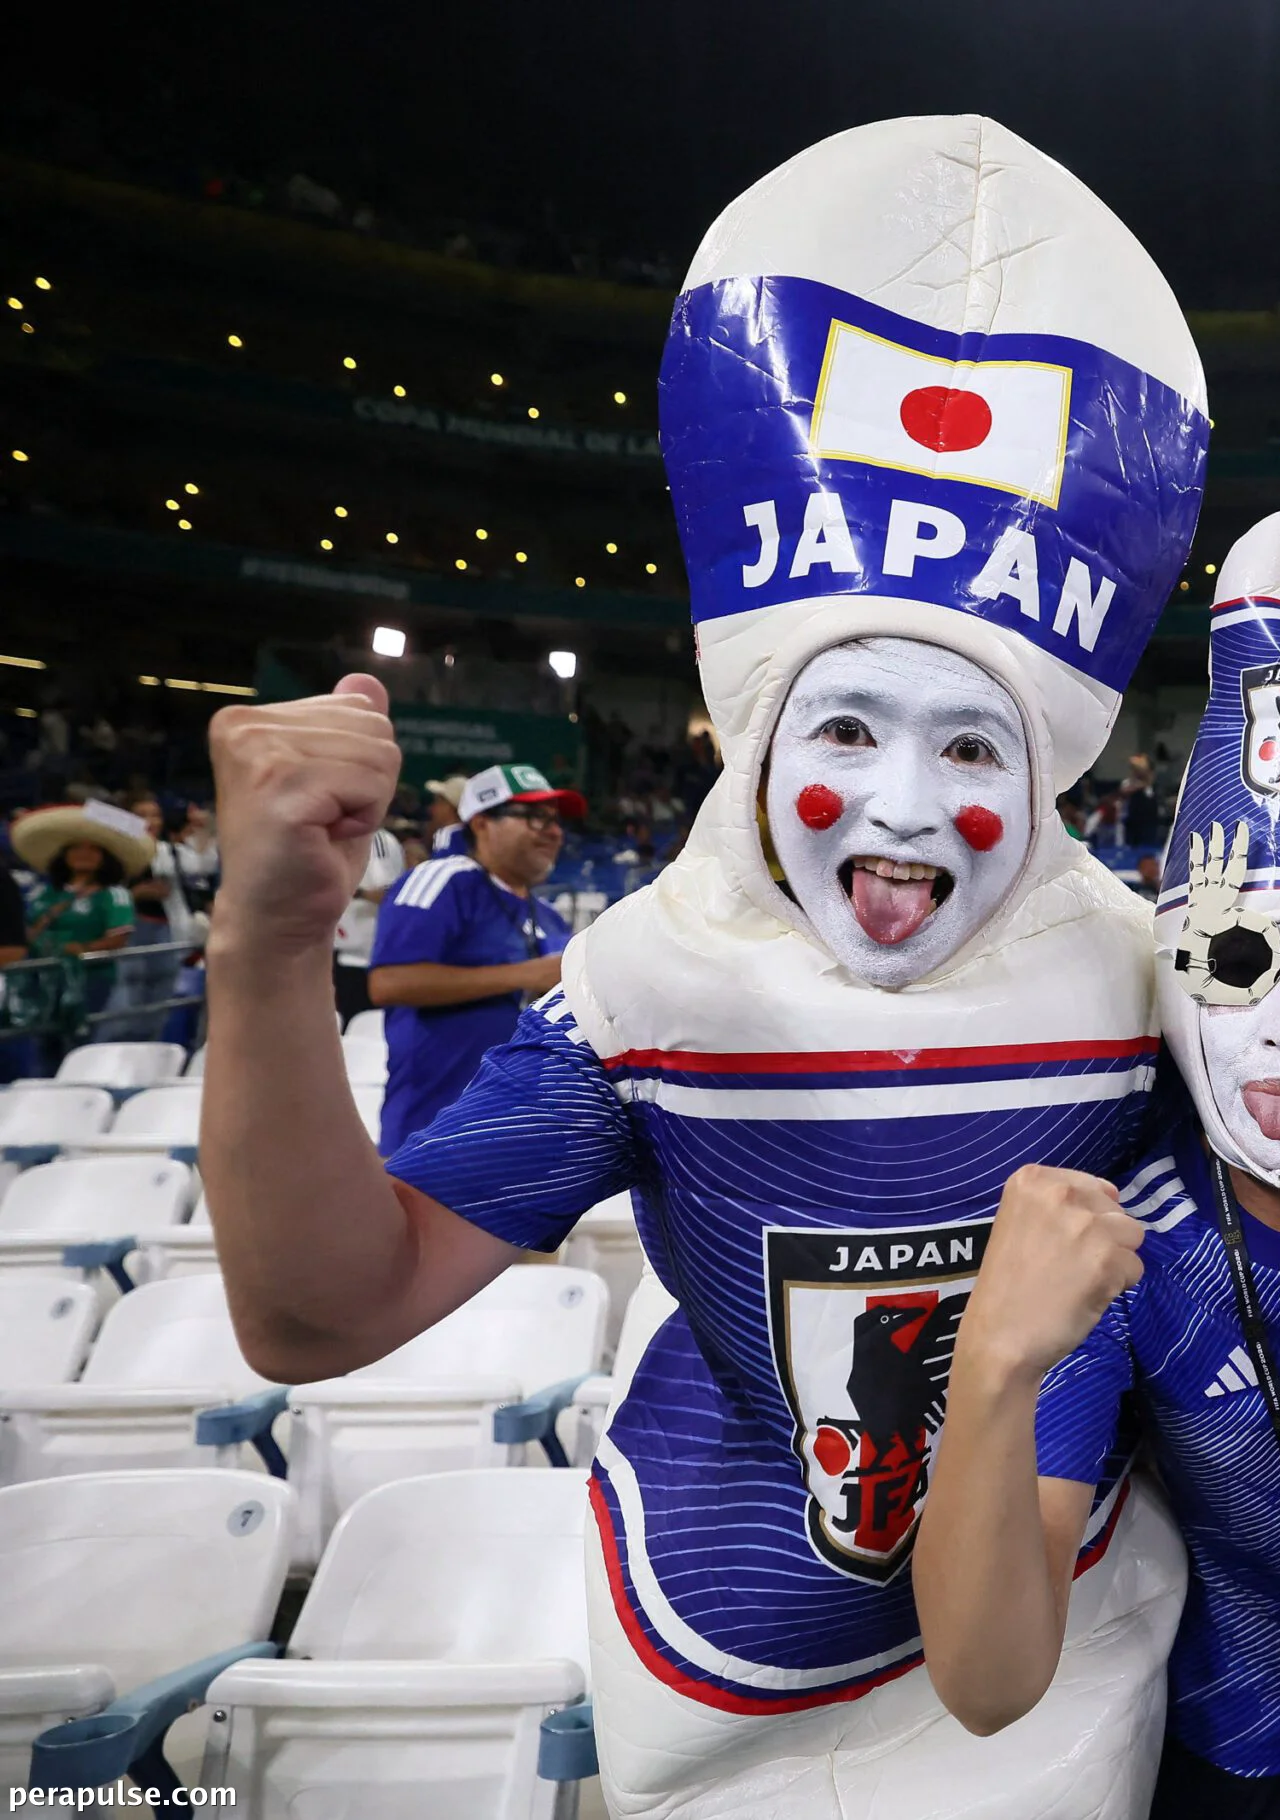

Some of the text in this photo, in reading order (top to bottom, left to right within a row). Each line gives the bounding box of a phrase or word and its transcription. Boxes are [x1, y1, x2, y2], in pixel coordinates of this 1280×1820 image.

[742, 491, 1117, 654] JAPAN
[1220, 1190, 1230, 1212] WORLD
[1224, 1212, 1232, 1225] FIFA
[829, 1236, 973, 1272] JAPAN
[1237, 1270, 1246, 1283] CUP
[1240, 1282, 1251, 1304] WORLD
[1245, 1304, 1253, 1318] FIFA
[1261, 1362, 1270, 1376] CUP
[1265, 1374, 1277, 1397] WORLD
[1271, 1396, 1280, 1411] FIFA
[832, 1463, 928, 1533] JFA
